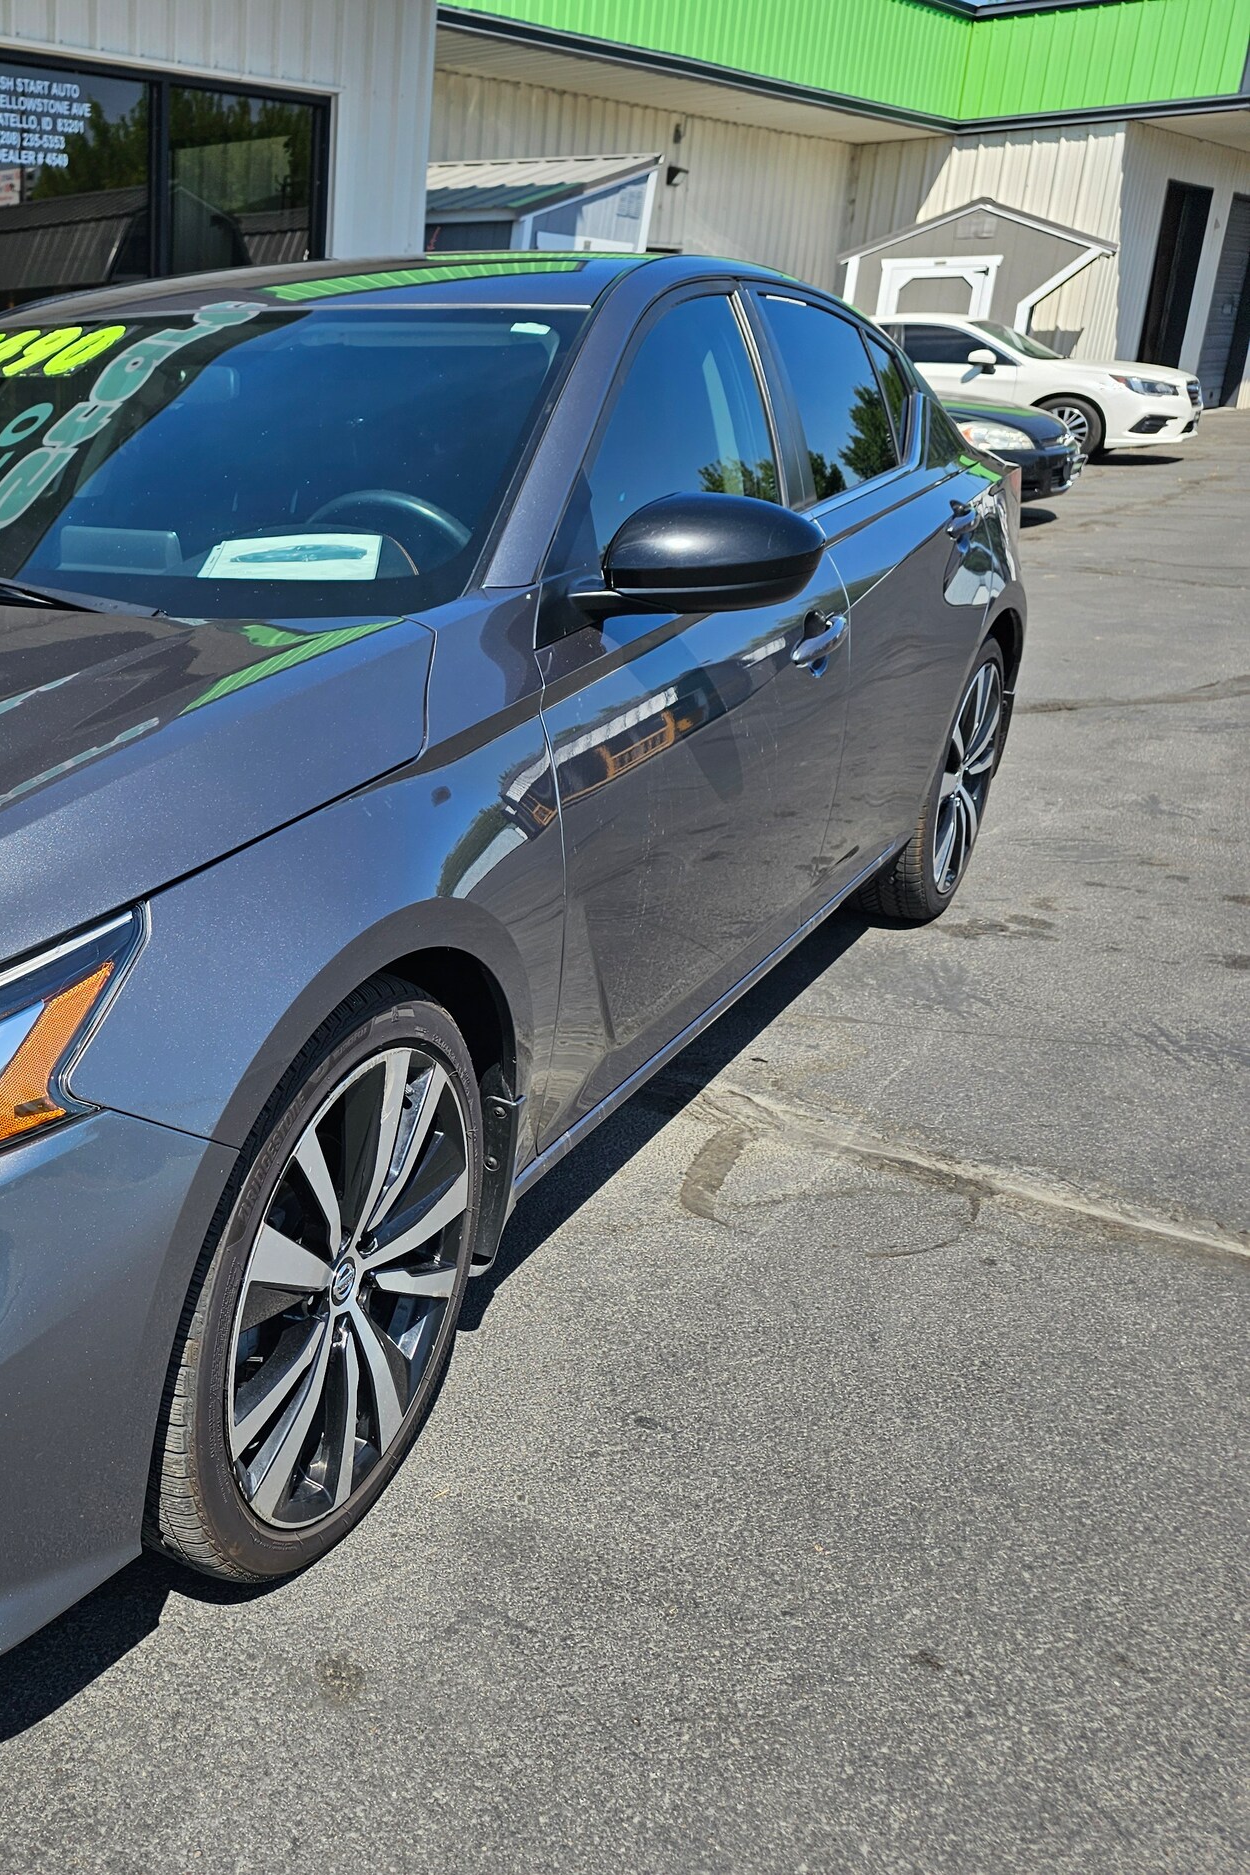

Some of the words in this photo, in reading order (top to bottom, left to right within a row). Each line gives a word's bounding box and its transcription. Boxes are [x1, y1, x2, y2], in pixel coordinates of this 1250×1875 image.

[16, 78, 50, 95] START
[51, 83, 80, 98] AUTO
[71, 102, 92, 118] AVE
[41, 117, 53, 130] ID
[56, 118, 85, 135] 83201
